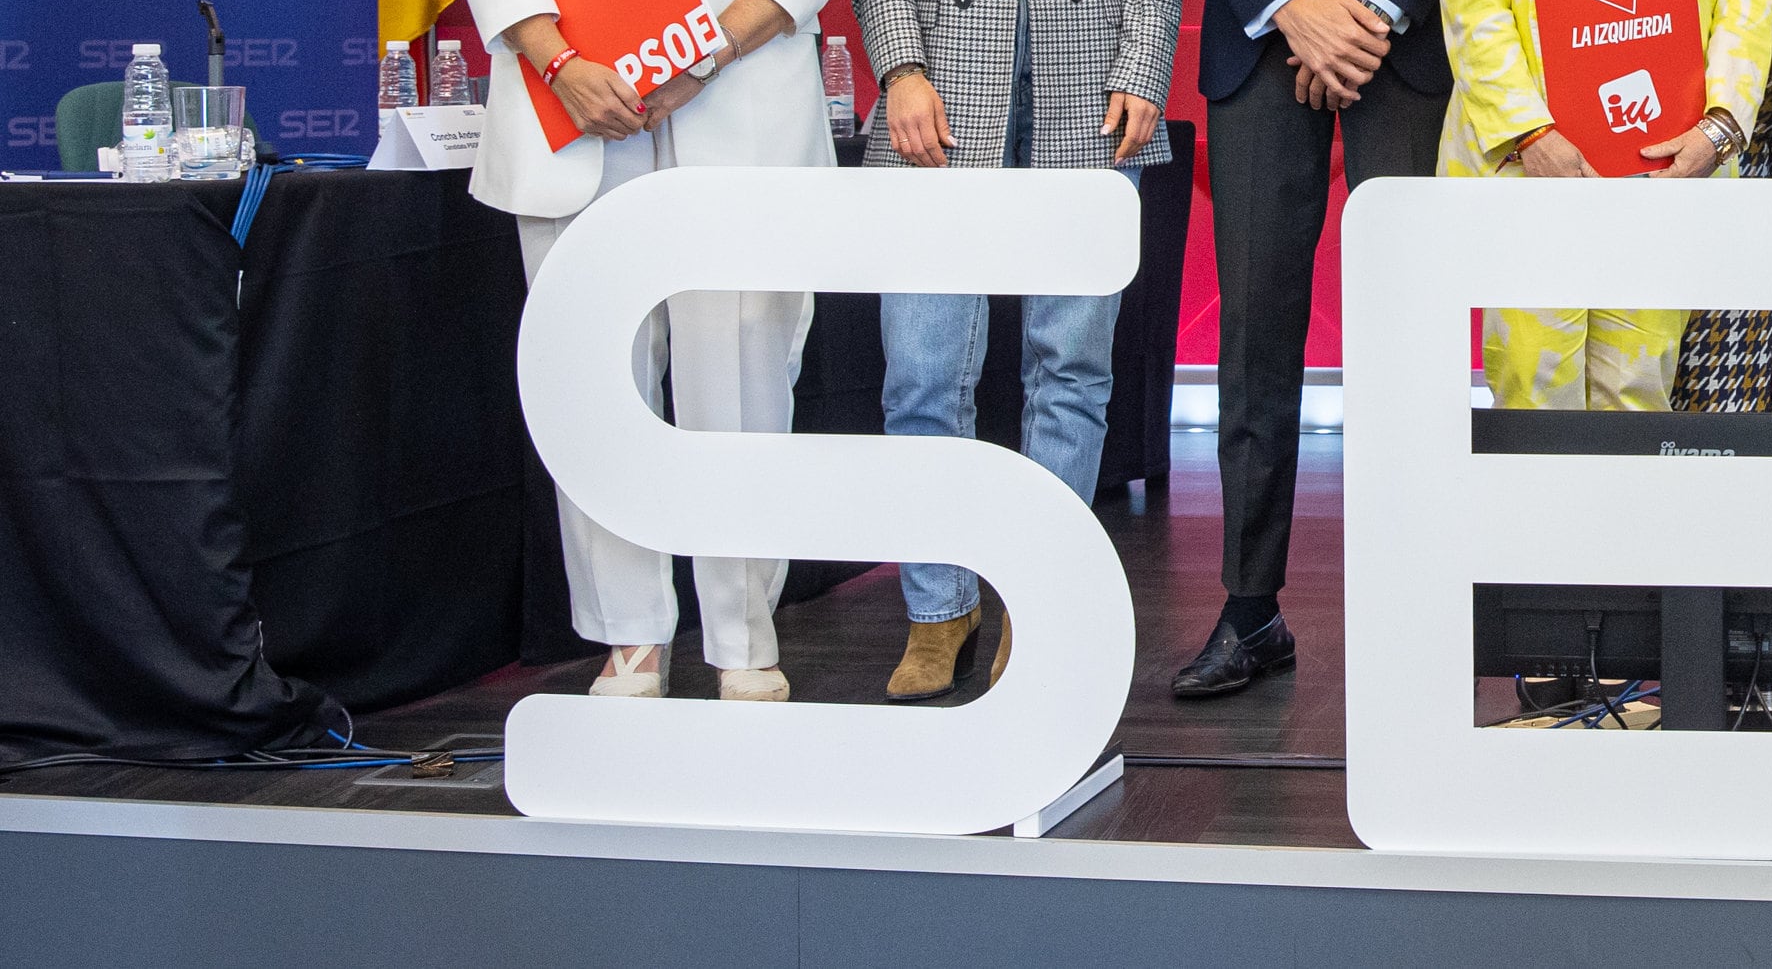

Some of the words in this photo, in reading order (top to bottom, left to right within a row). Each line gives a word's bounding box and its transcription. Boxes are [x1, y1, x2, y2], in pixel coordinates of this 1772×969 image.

[614, 4, 728, 96] PSOE
[1571, 25, 1592, 49] LA
[1594, 12, 1673, 46] IZQUIERDA
